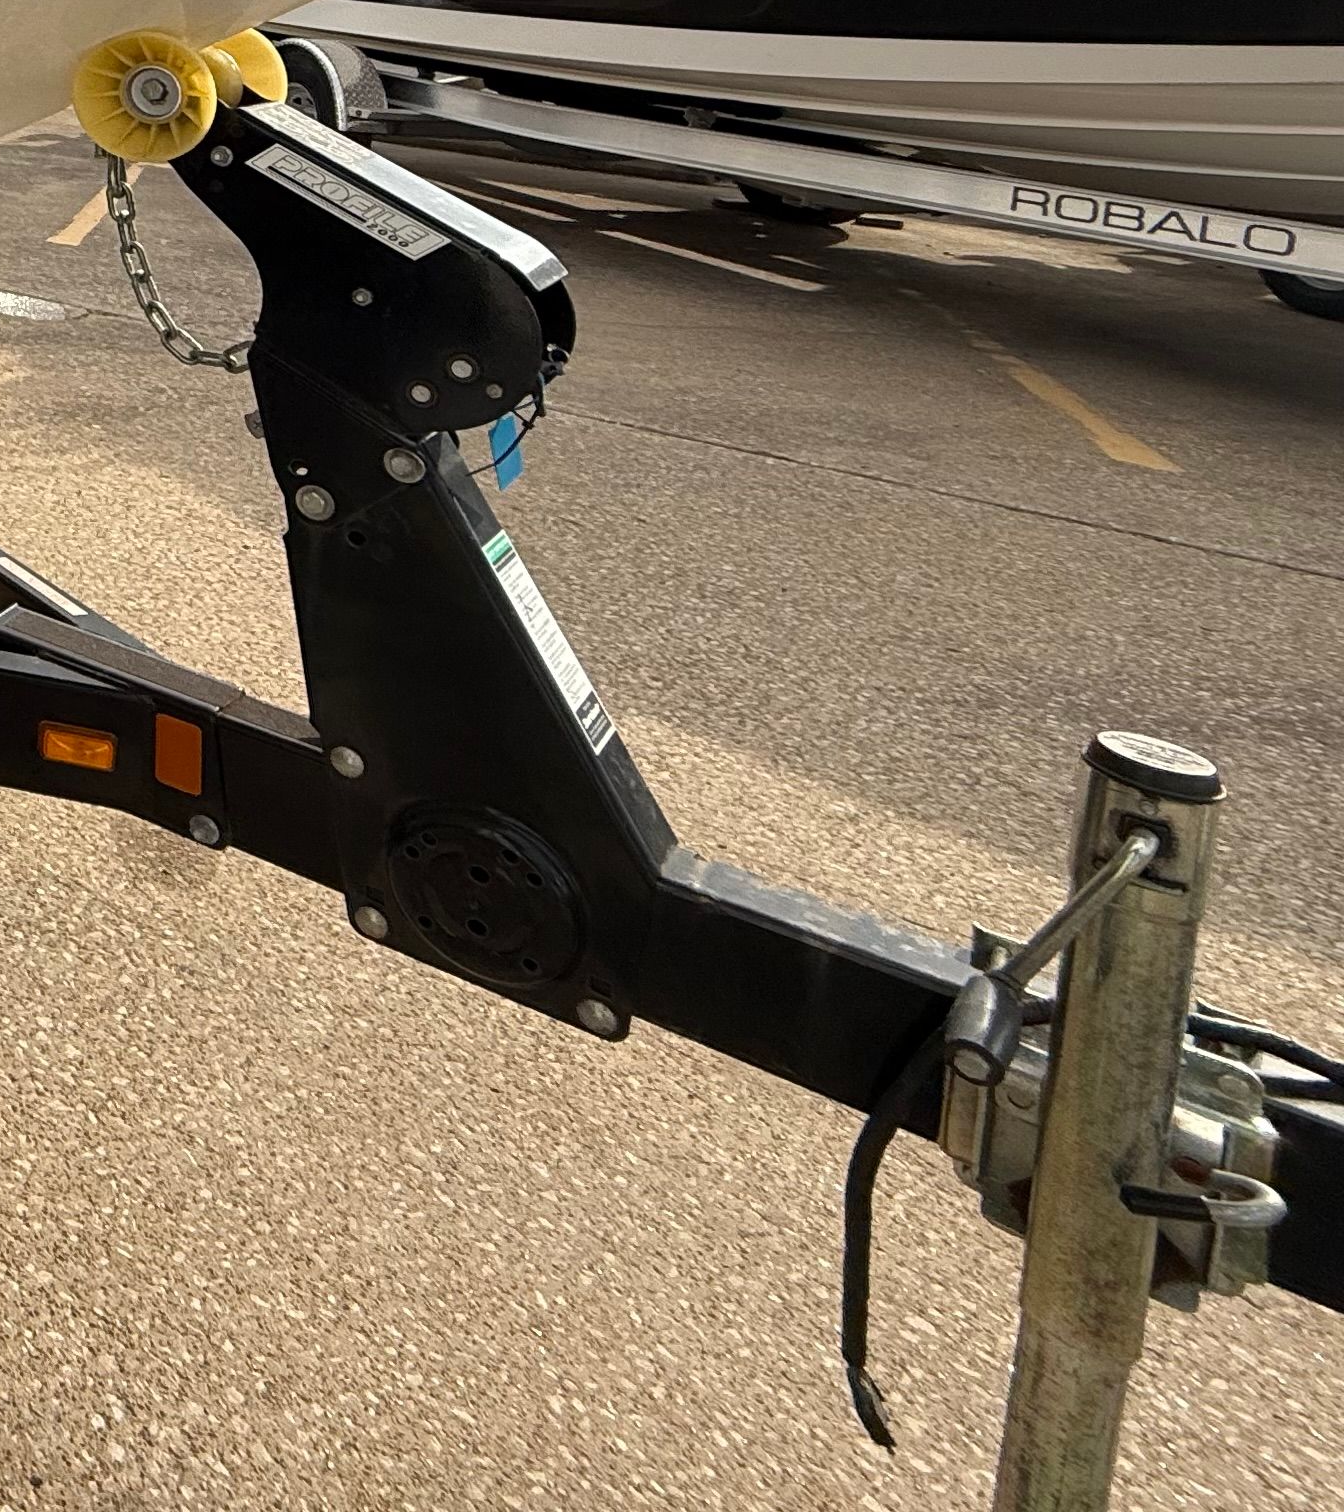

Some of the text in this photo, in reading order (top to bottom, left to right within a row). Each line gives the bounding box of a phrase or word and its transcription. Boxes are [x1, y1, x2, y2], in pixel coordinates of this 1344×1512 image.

[272, 154, 429, 244] PROFILE
[1010, 186, 1297, 256] ROBALO
[366, 222, 410, 248] 2000
